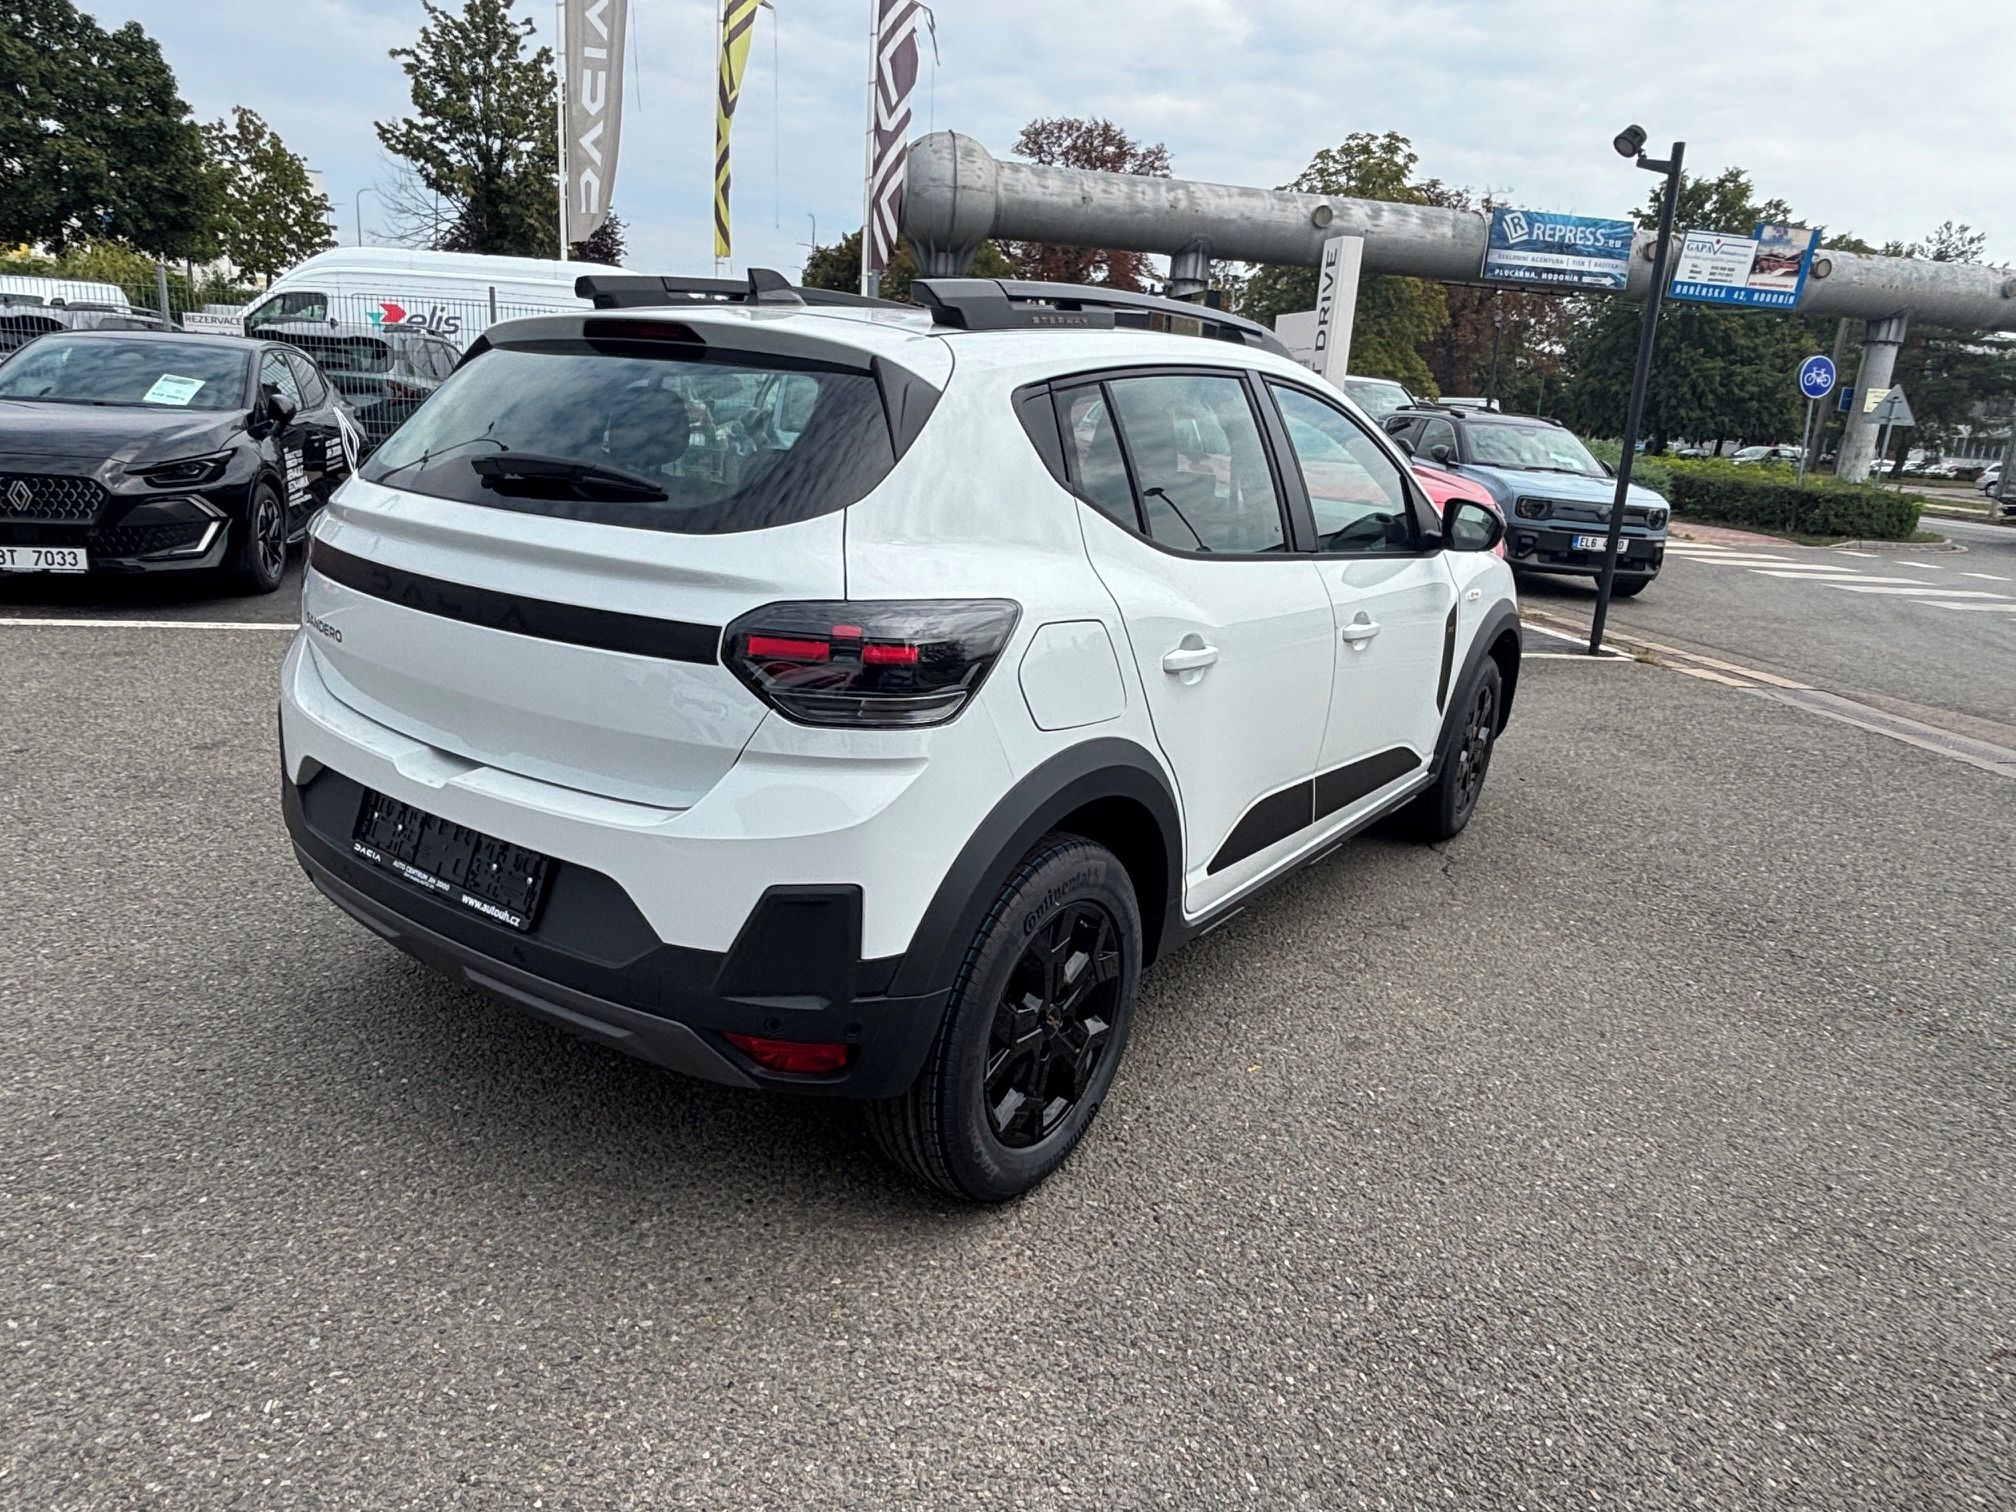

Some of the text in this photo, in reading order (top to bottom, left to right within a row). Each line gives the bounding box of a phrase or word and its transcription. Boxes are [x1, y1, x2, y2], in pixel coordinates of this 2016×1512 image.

[578, 0, 608, 214] DACIA
[1531, 222, 1622, 248] REPRESS.eu
[1315, 248, 1338, 352] DRIVE
[1752, 291, 1796, 304] HODONÍN
[184, 315, 242, 326] REZERVACE
[406, 305, 462, 335] elis
[32, 550, 78, 567] 7033
[306, 610, 342, 643] SANDERO
[353, 842, 382, 862] DACIA
